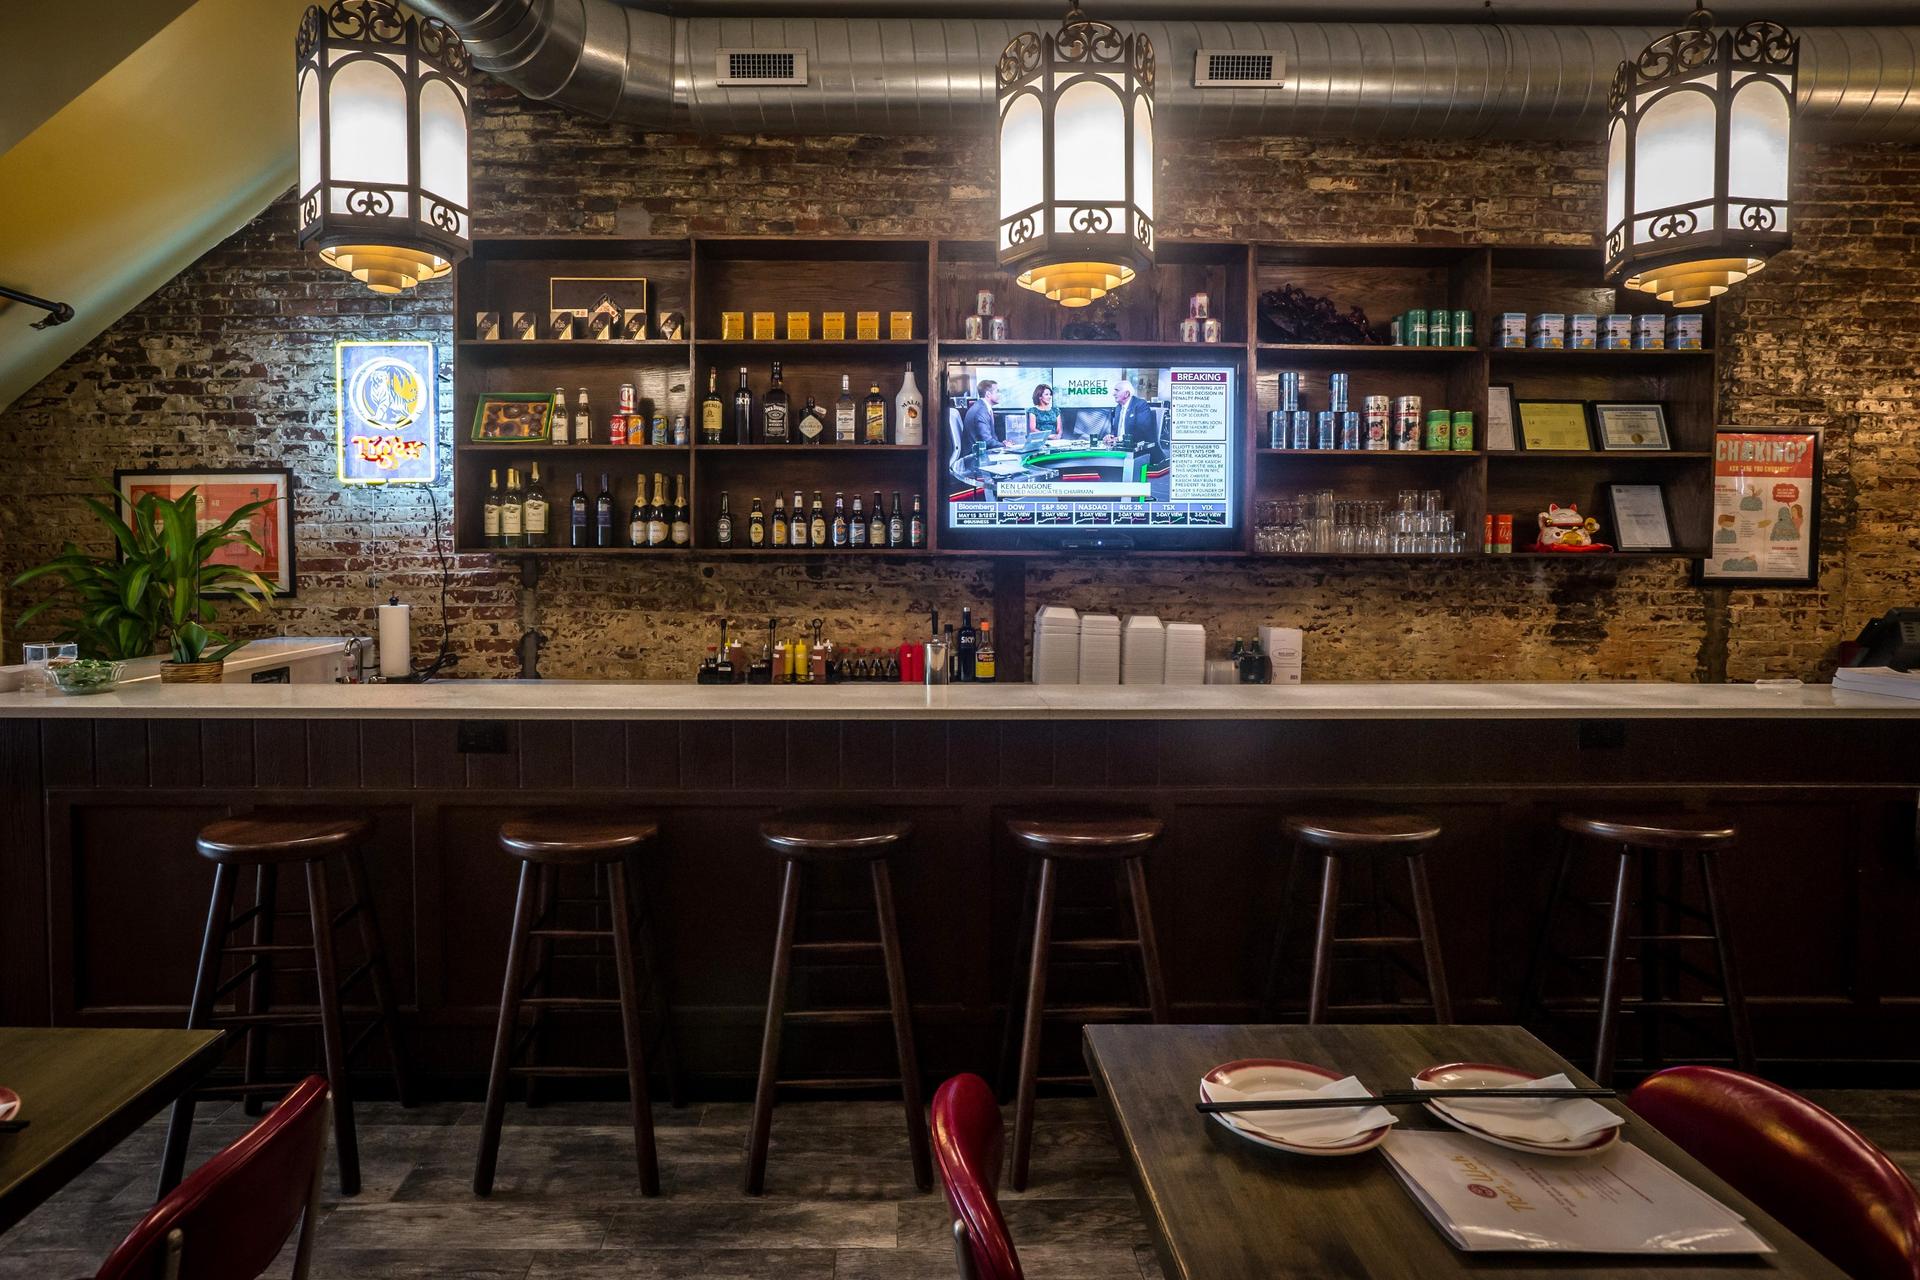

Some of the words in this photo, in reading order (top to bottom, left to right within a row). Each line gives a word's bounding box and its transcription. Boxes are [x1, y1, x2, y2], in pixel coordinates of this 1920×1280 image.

[1177, 373, 1221, 381] BREAKING
[1068, 379, 1108, 387] MARKET
[1067, 387, 1108, 395] MAKERS
[351, 435, 426, 470] Tiger
[1715, 440, 1808, 463] CHOKING?
